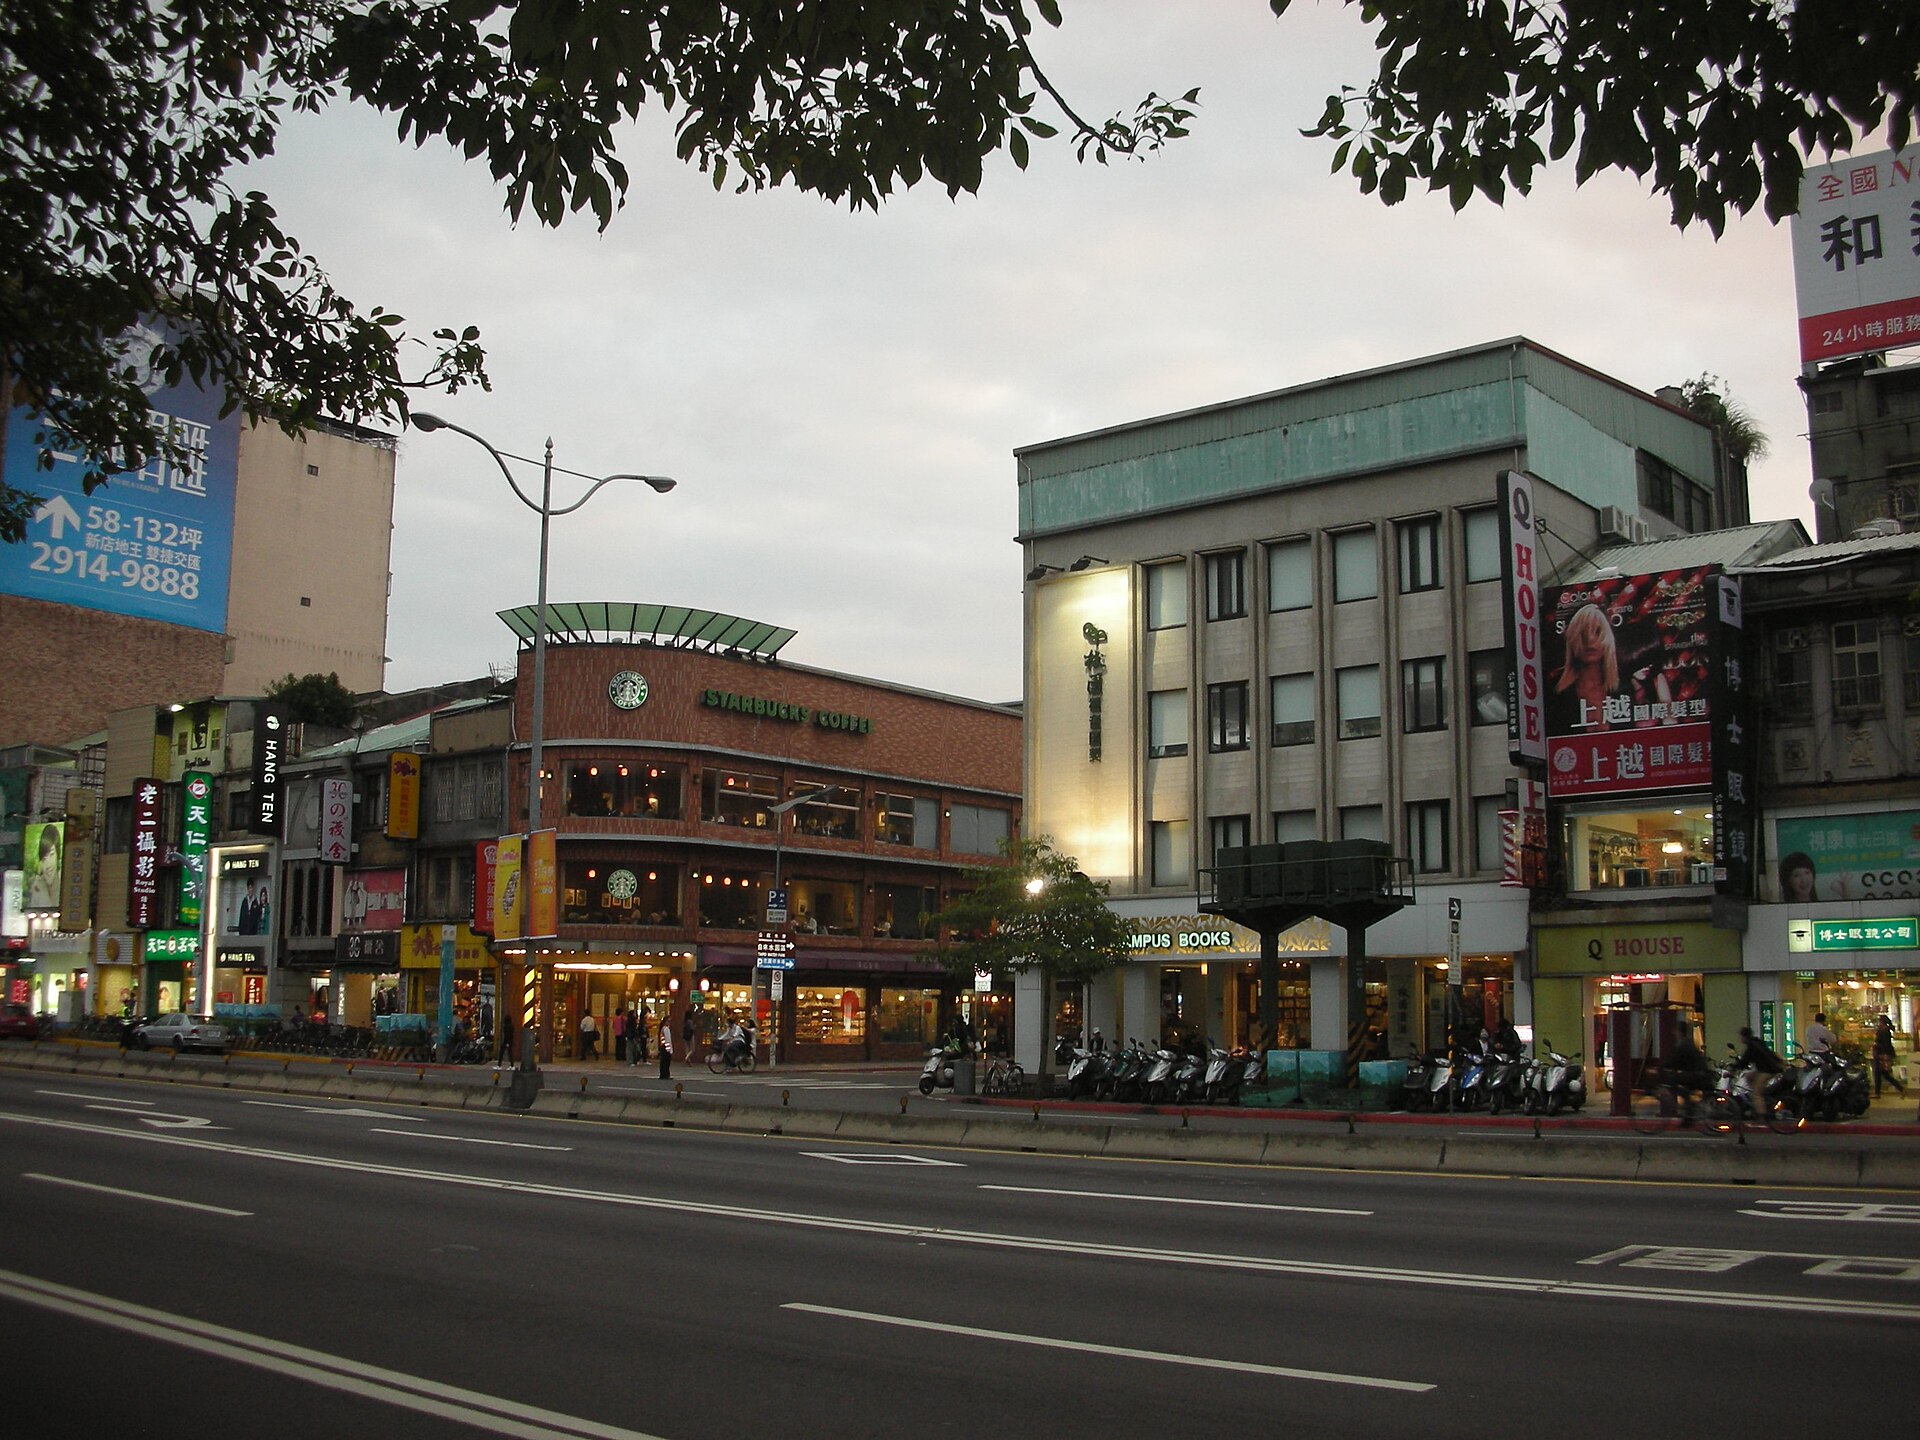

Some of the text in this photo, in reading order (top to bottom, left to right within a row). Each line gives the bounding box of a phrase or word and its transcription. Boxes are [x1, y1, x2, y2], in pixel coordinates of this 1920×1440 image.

[1817, 157, 1920, 203] 全國 N
[85, 532, 142, 559] 新店地王
[86, 505, 203, 552] 58-132坪
[29, 541, 200, 600] 2914-9888
[1512, 487, 1541, 743] Q HOUSE
[611, 672, 646, 690] STARBUCKS
[614, 696, 641, 708] COFFEE
[703, 688, 873, 735] STARBUCKS COFFEE
[1584, 741, 1711, 783] 上越國際髮
[1725, 655, 1748, 864] 博士眼鏡
[261, 739, 278, 824] HANG TEN
[136, 783, 158, 879] 老二攝影
[231, 859, 260, 869] HANG TEN
[769, 890, 777, 903] P
[1178, 931, 1231, 948] BOOKS
[1588, 936, 1685, 961] Q HOUSE
[1819, 926, 1911, 942] 博士眼鏡公司
[228, 953, 255, 962] HANG TEN
[1762, 1009, 1774, 1051] 博士眼
